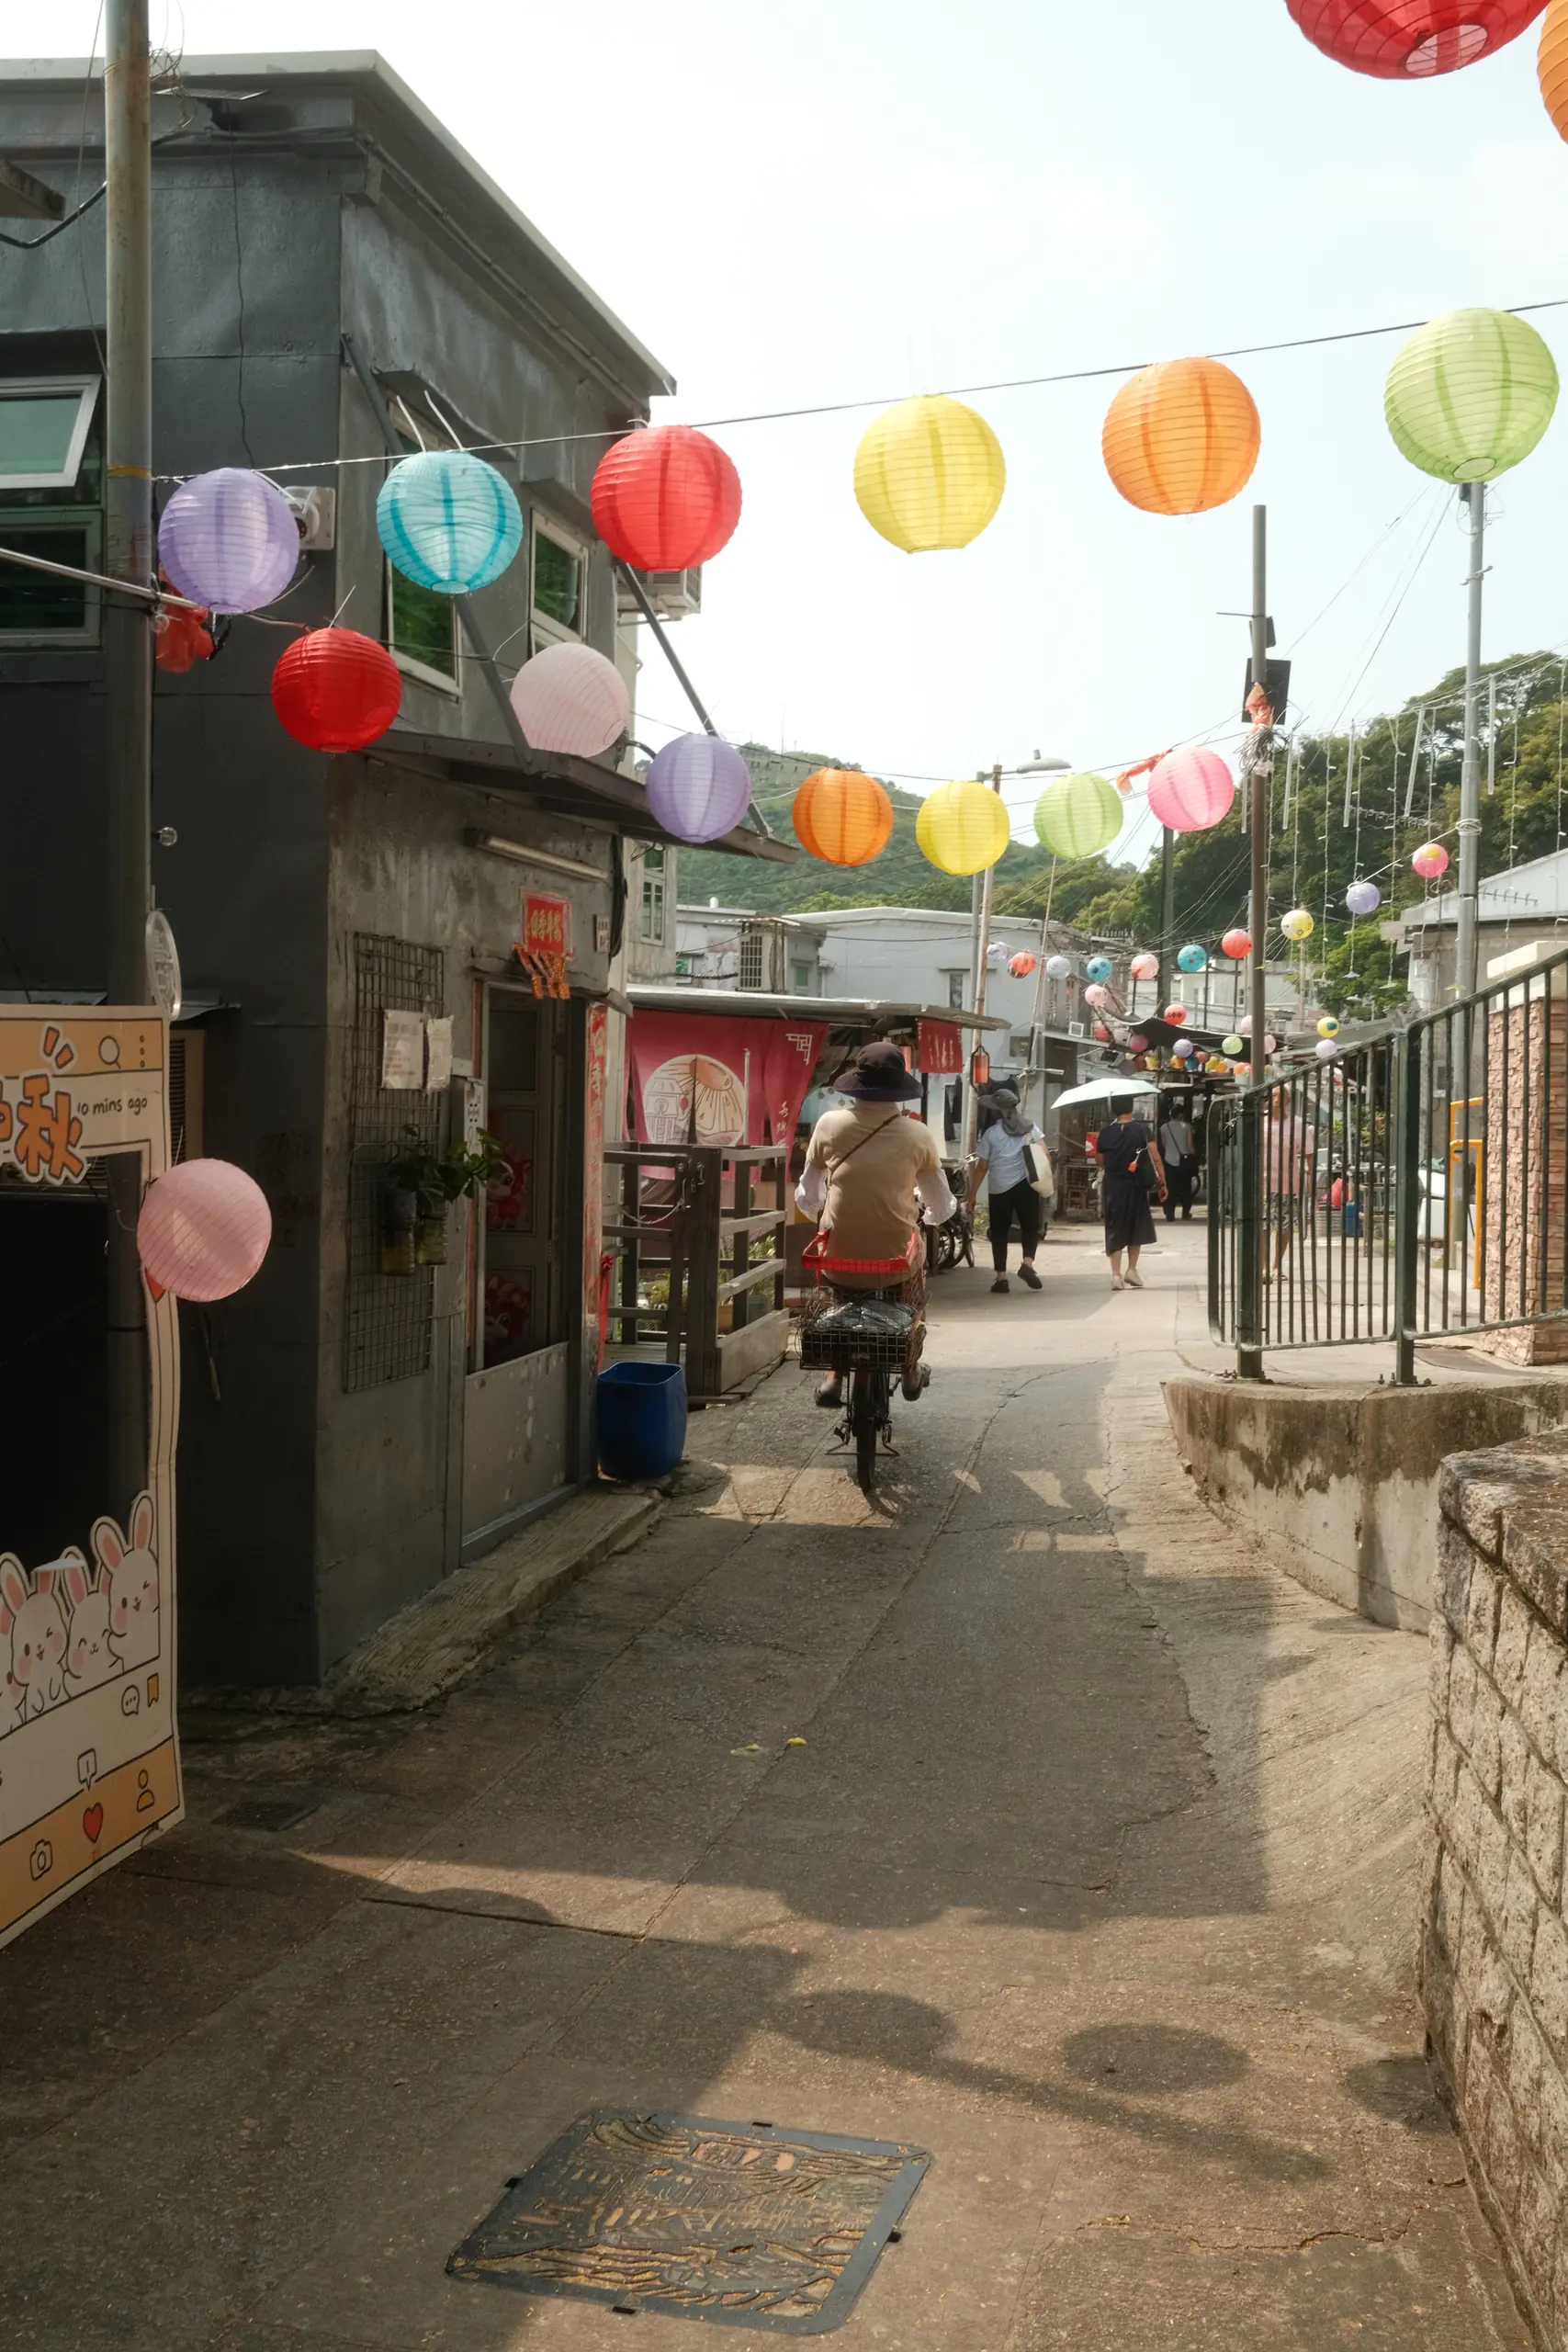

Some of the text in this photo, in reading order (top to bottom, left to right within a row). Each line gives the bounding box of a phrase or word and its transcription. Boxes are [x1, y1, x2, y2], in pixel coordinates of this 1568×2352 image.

[77, 1096, 148, 1116] 10 mins ago
